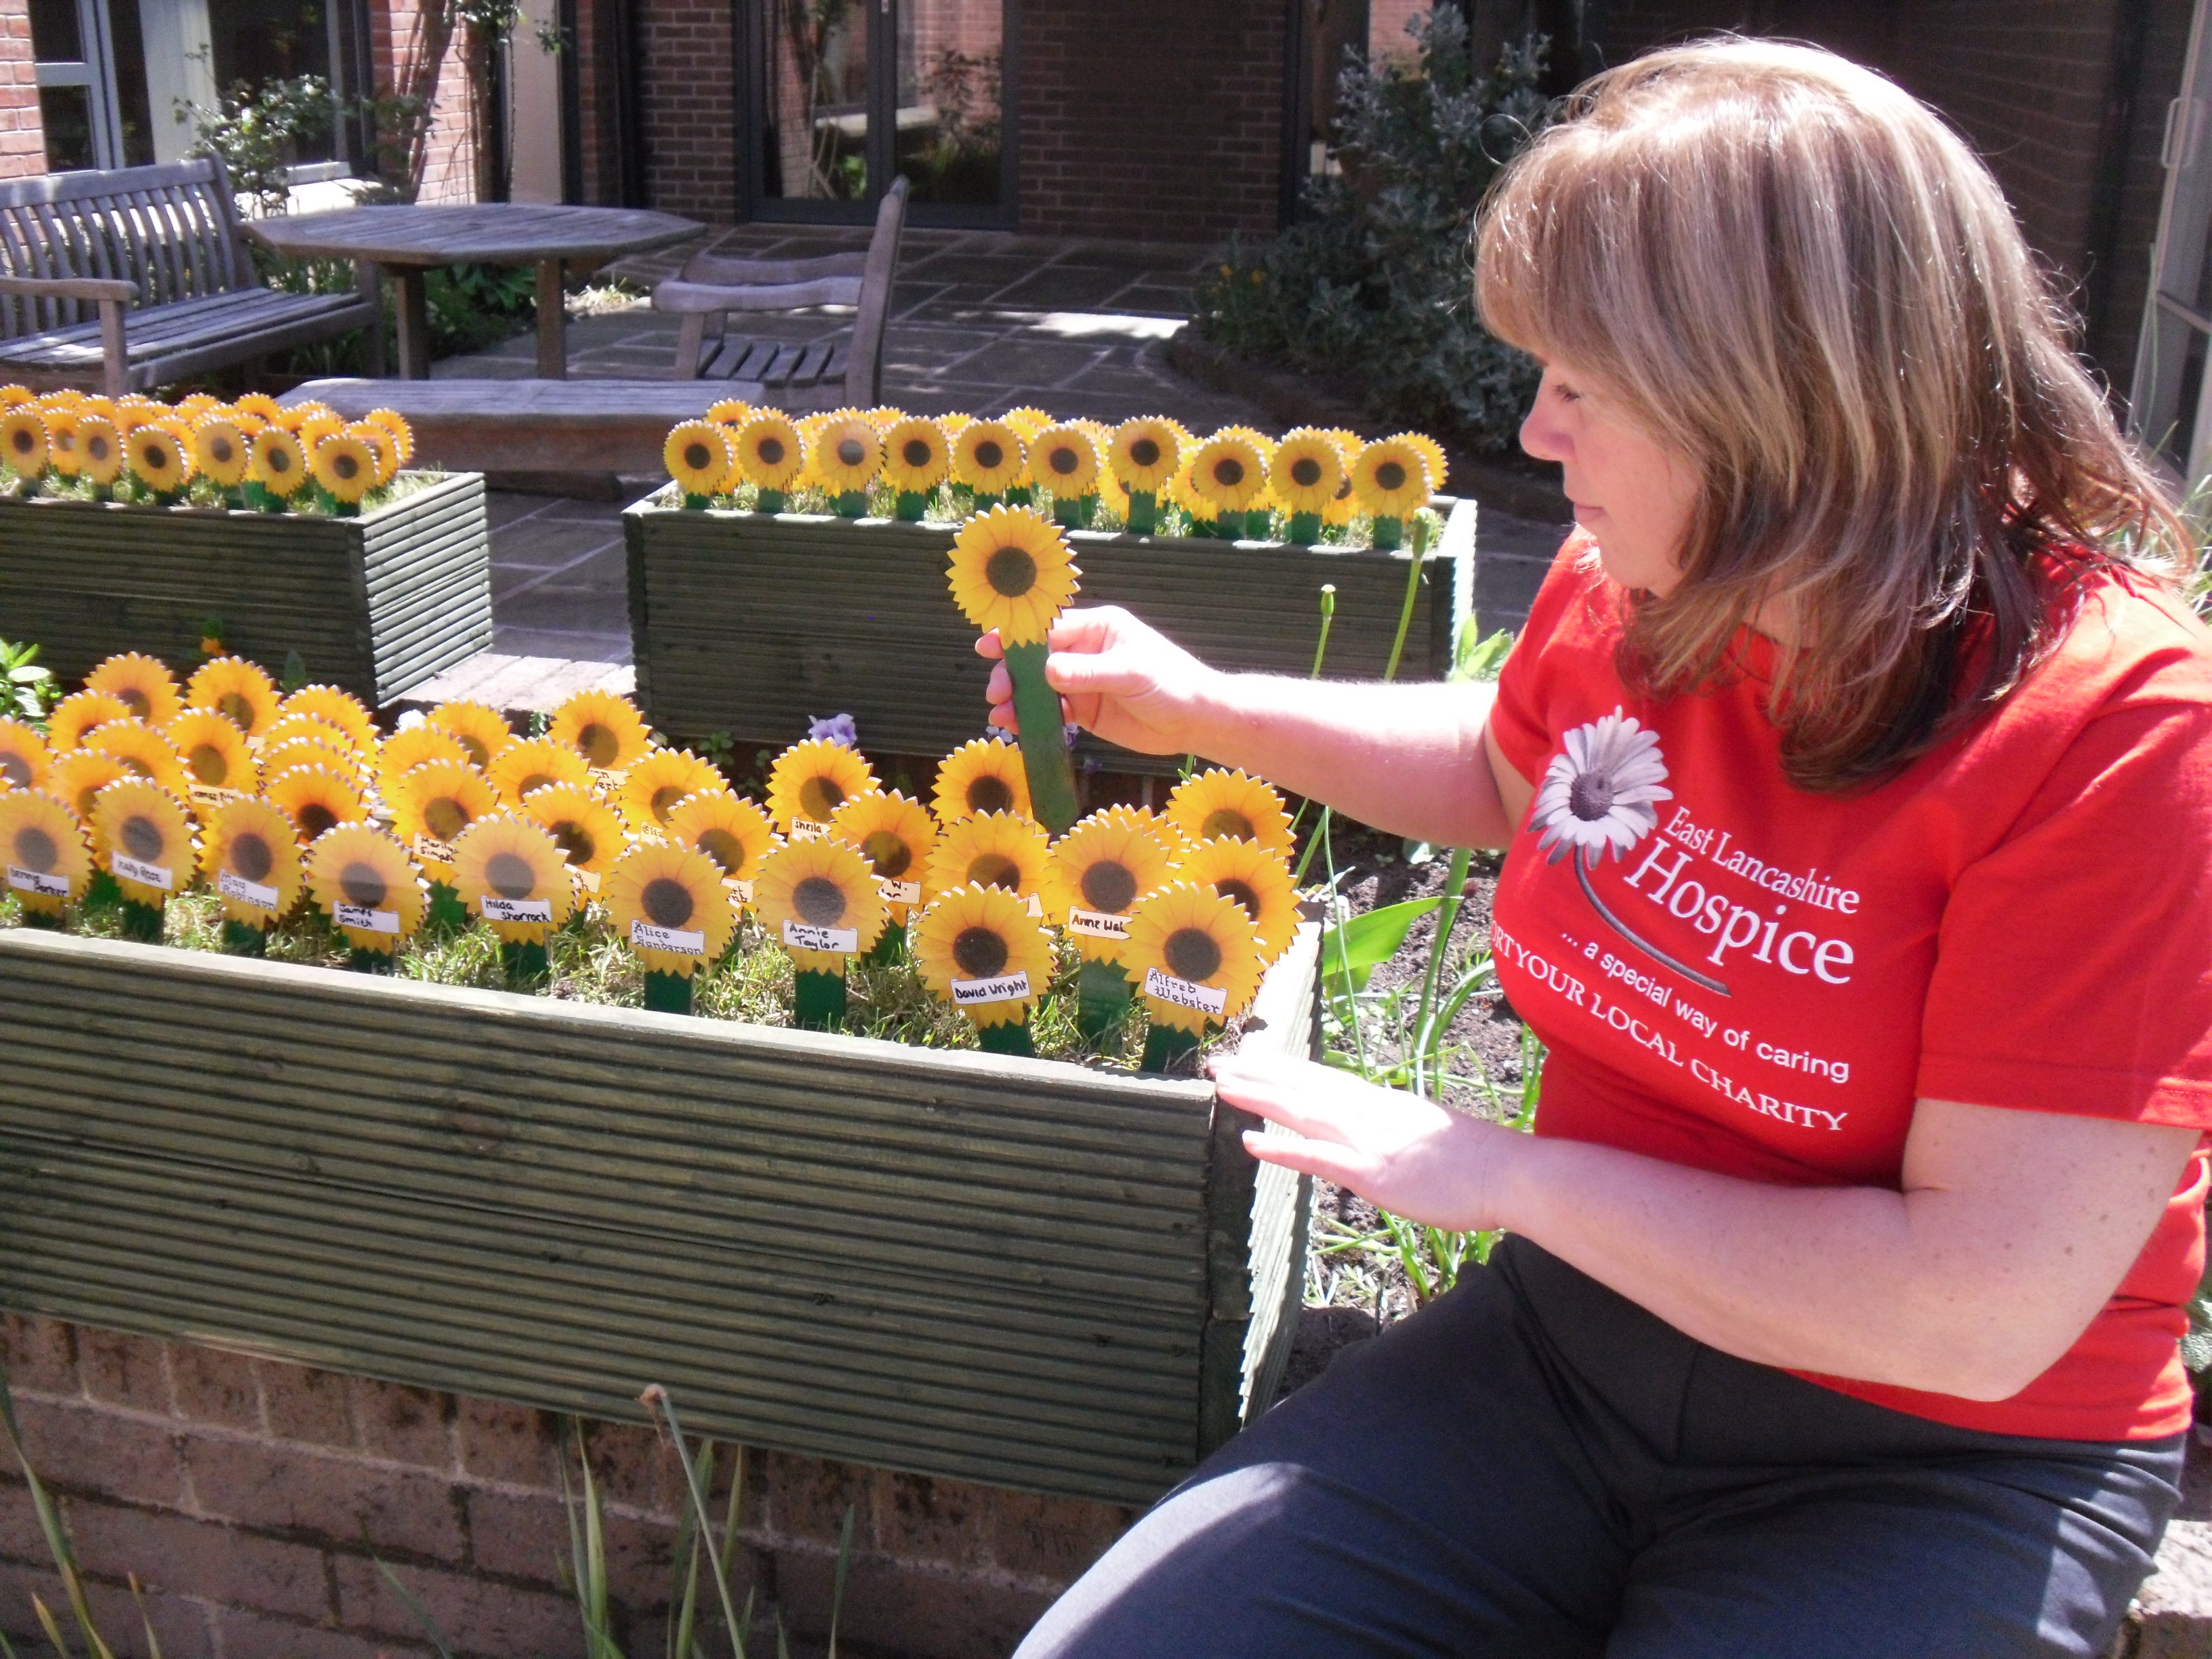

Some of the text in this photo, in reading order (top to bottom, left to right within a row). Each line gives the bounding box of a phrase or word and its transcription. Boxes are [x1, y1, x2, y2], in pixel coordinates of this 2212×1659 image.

[1663, 806, 1860, 915] East Lancashire
[485, 900, 515, 910] Hilda
[1624, 837, 1854, 985] Hospice
[339, 914, 372, 927] Smith
[1072, 914, 1101, 929] Anne
[634, 922, 670, 939] Alice
[790, 924, 829, 938] Annie
[794, 935, 839, 951] Taylor
[1149, 970, 1196, 994] Alfred
[955, 987, 987, 999] David
[1155, 986, 1220, 1013] Webster
[1584, 943, 1599, 958] a
[1601, 954, 1672, 1008] special
[1675, 999, 1717, 1039] way
[1723, 1029, 1750, 1051] of
[1757, 1042, 1849, 1084] caring
[1515, 943, 1586, 1006] YOUR
[1591, 993, 1684, 1067] LOCAL
[1691, 1059, 1848, 1130] CHARITY
